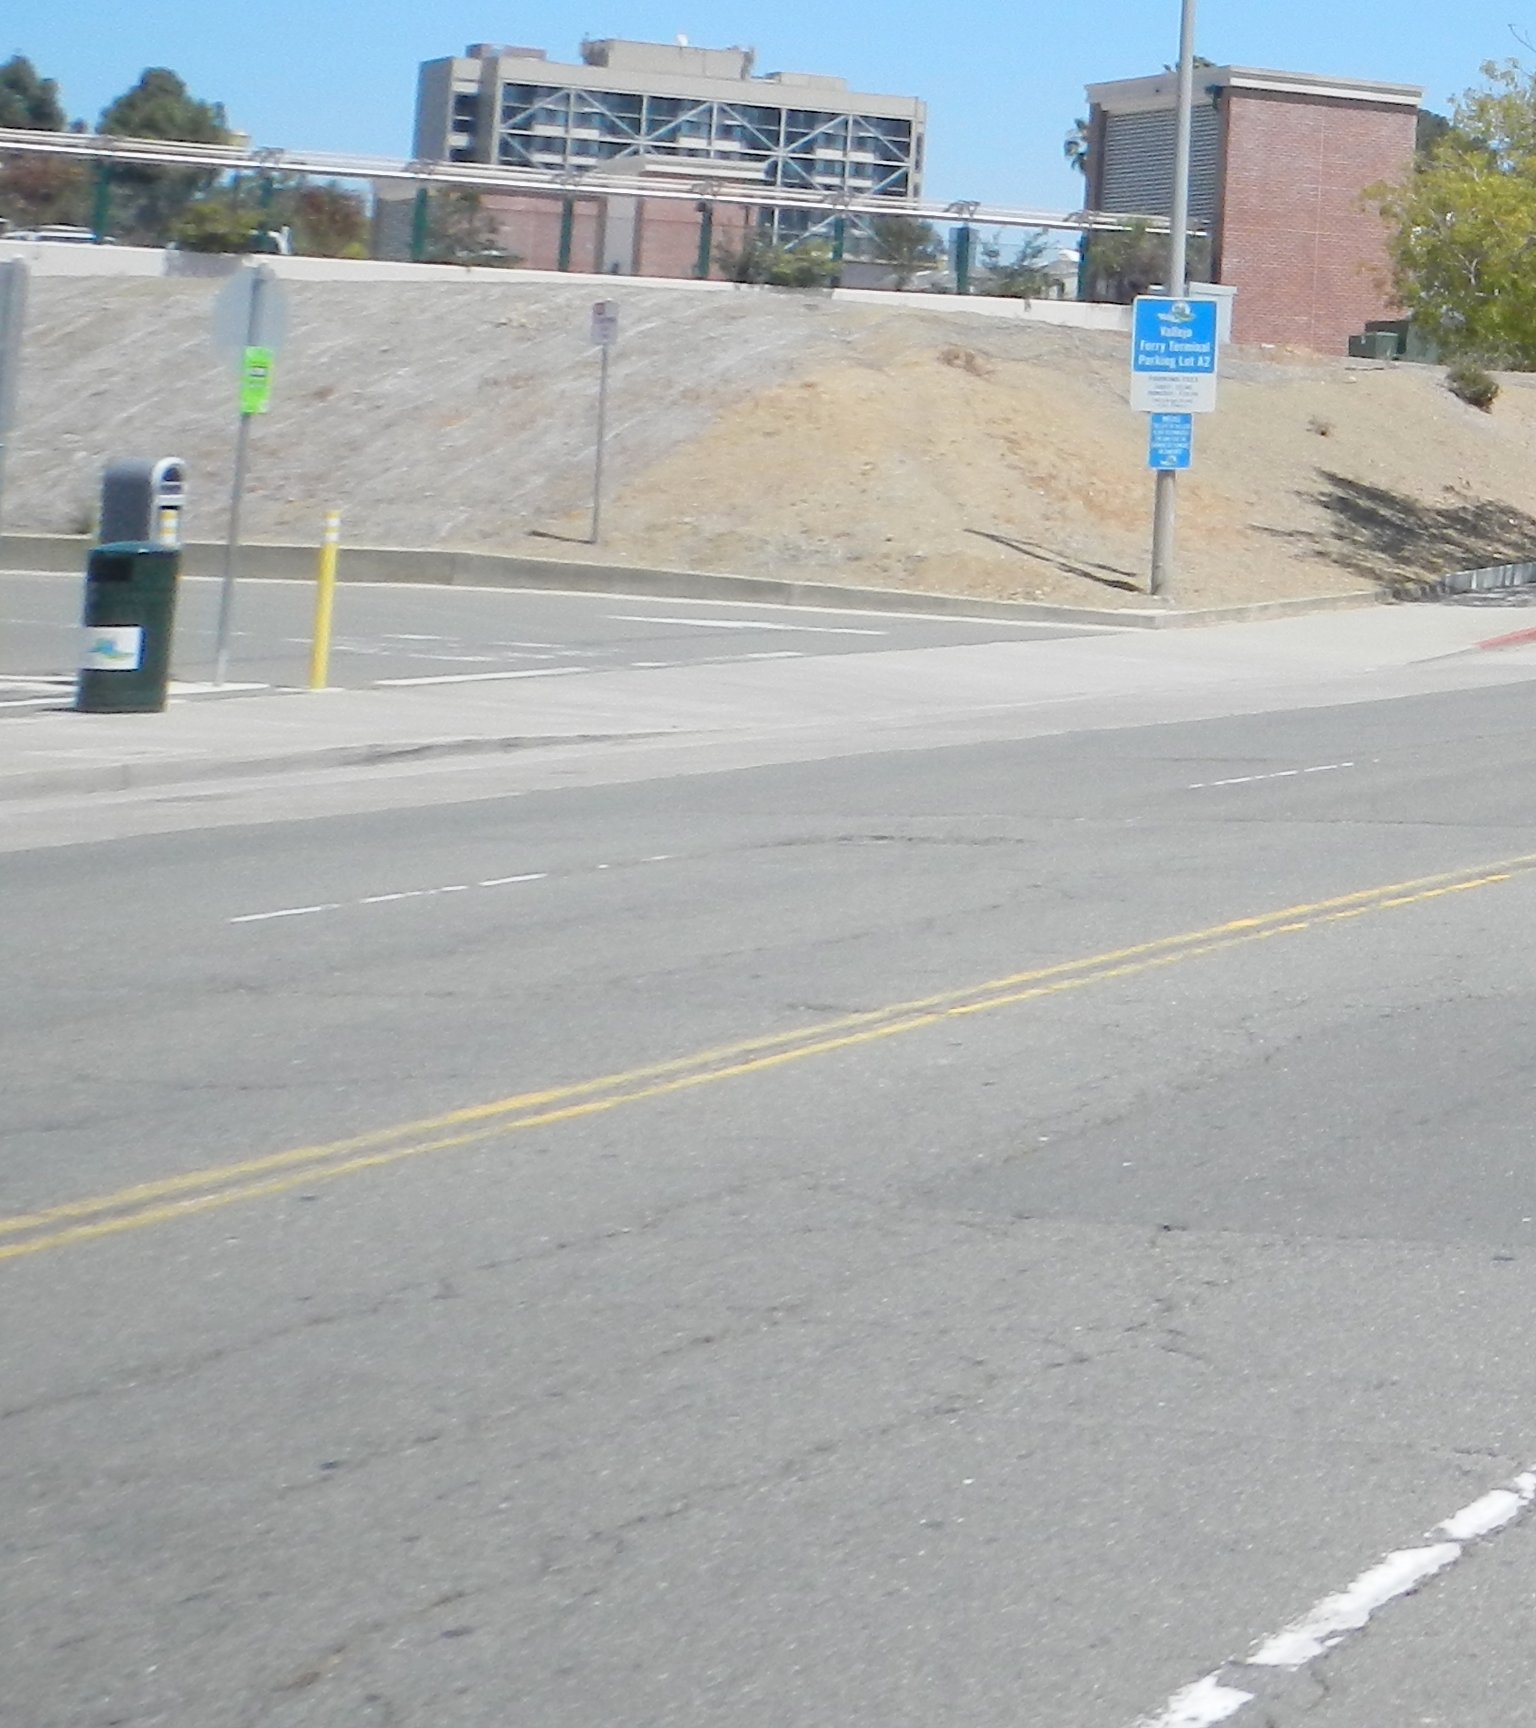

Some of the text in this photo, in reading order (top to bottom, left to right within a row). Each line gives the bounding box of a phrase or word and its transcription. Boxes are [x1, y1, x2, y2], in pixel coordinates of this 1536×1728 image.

[1140, 340, 1210, 353] Ferry Terminal
[1138, 354, 1176, 369] Parking
[1179, 356, 1194, 367] Lot
